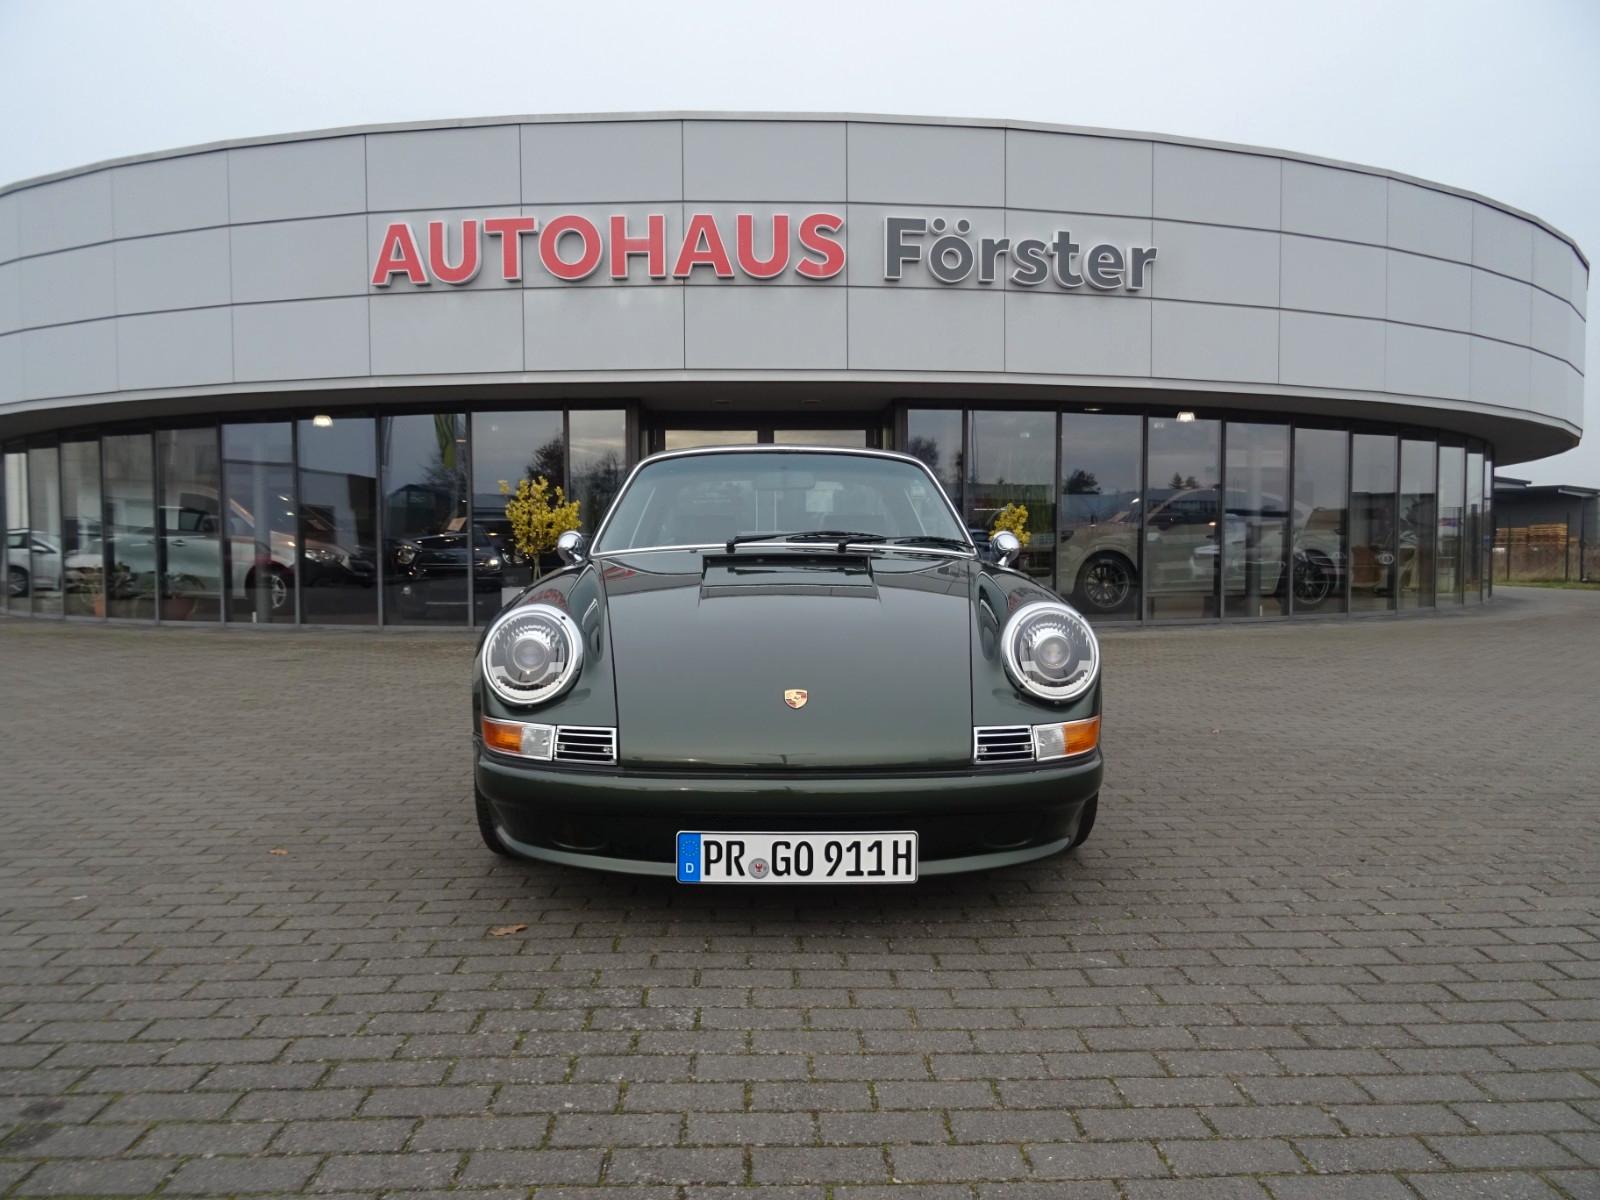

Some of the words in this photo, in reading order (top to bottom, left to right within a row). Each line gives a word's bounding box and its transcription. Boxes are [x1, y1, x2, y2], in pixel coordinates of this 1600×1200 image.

[371, 213, 846, 287] AUTOHAUS
[884, 215, 1157, 290] Förster
[685, 862, 695, 874] D
[703, 840, 746, 876] PR
[771, 840, 814, 877] GO
